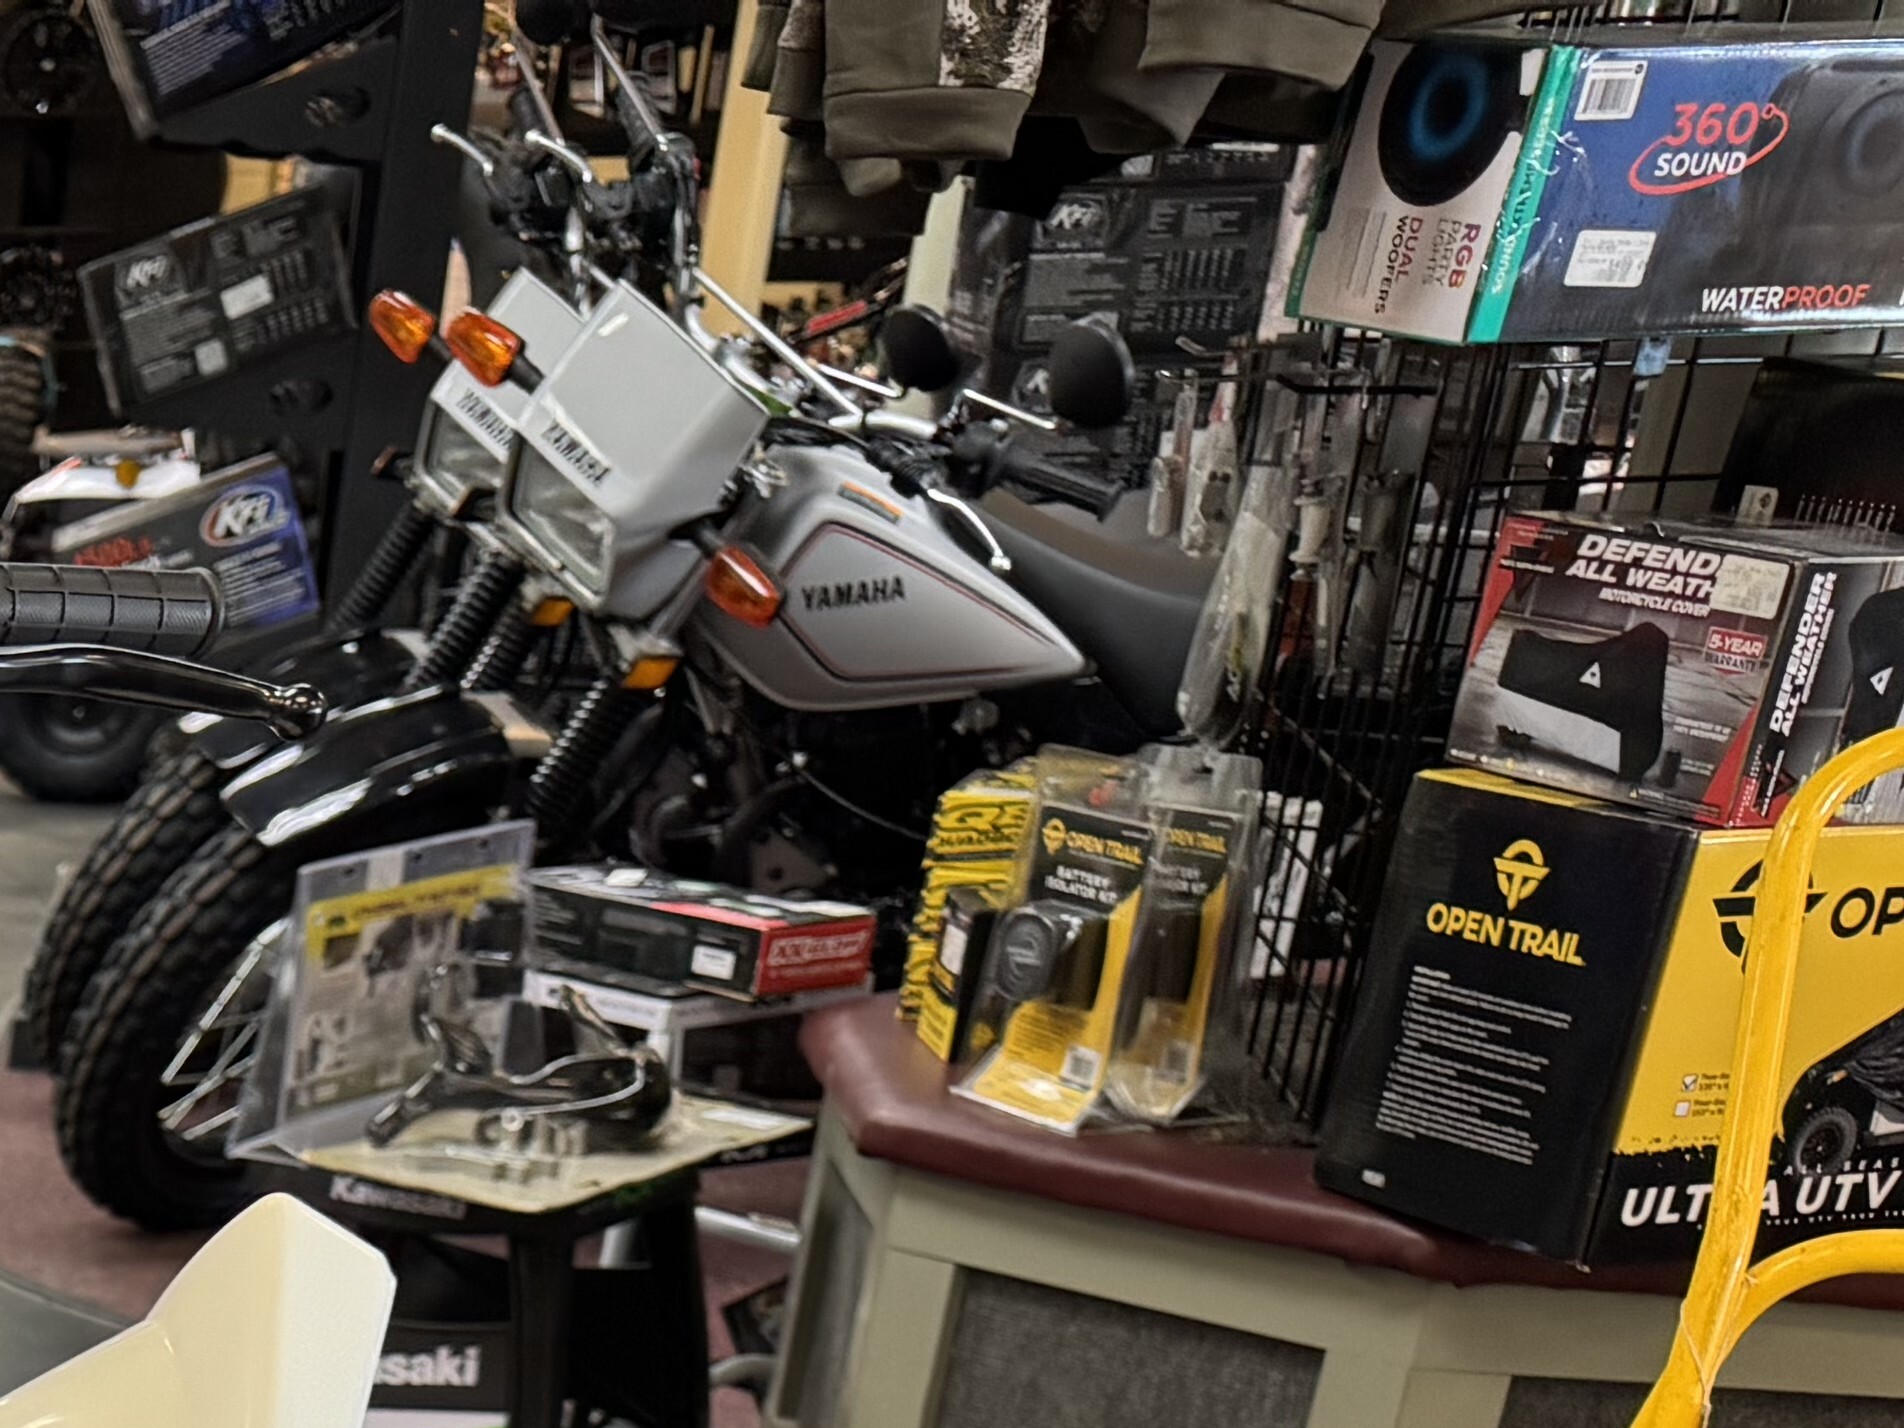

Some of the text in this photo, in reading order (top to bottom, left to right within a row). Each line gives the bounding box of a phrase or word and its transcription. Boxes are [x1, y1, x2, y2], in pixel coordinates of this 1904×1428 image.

[1653, 151, 1747, 177] SOUND
[1374, 215, 1409, 314] WOOFERS
[1395, 216, 1423, 283] DUAL
[1434, 220, 1462, 287] PARTY
[1448, 222, 1482, 288] RGB
[1701, 283, 1872, 313] WATERPROOF
[1576, 534, 1723, 577] DEFEND
[801, 575, 906, 612] YAMAHA
[1565, 559, 1618, 584] ALL
[1625, 567, 1717, 600] WEATH
[1707, 632, 1764, 658] 5-YEAR
[1769, 572, 1826, 733] DEFENDER
[1055, 864, 1112, 889] BATTERY
[1426, 901, 1587, 967] OPEN TRAIL
[1620, 1169, 1904, 1228] ULTA UTV
[374, 1343, 482, 1388] saki
